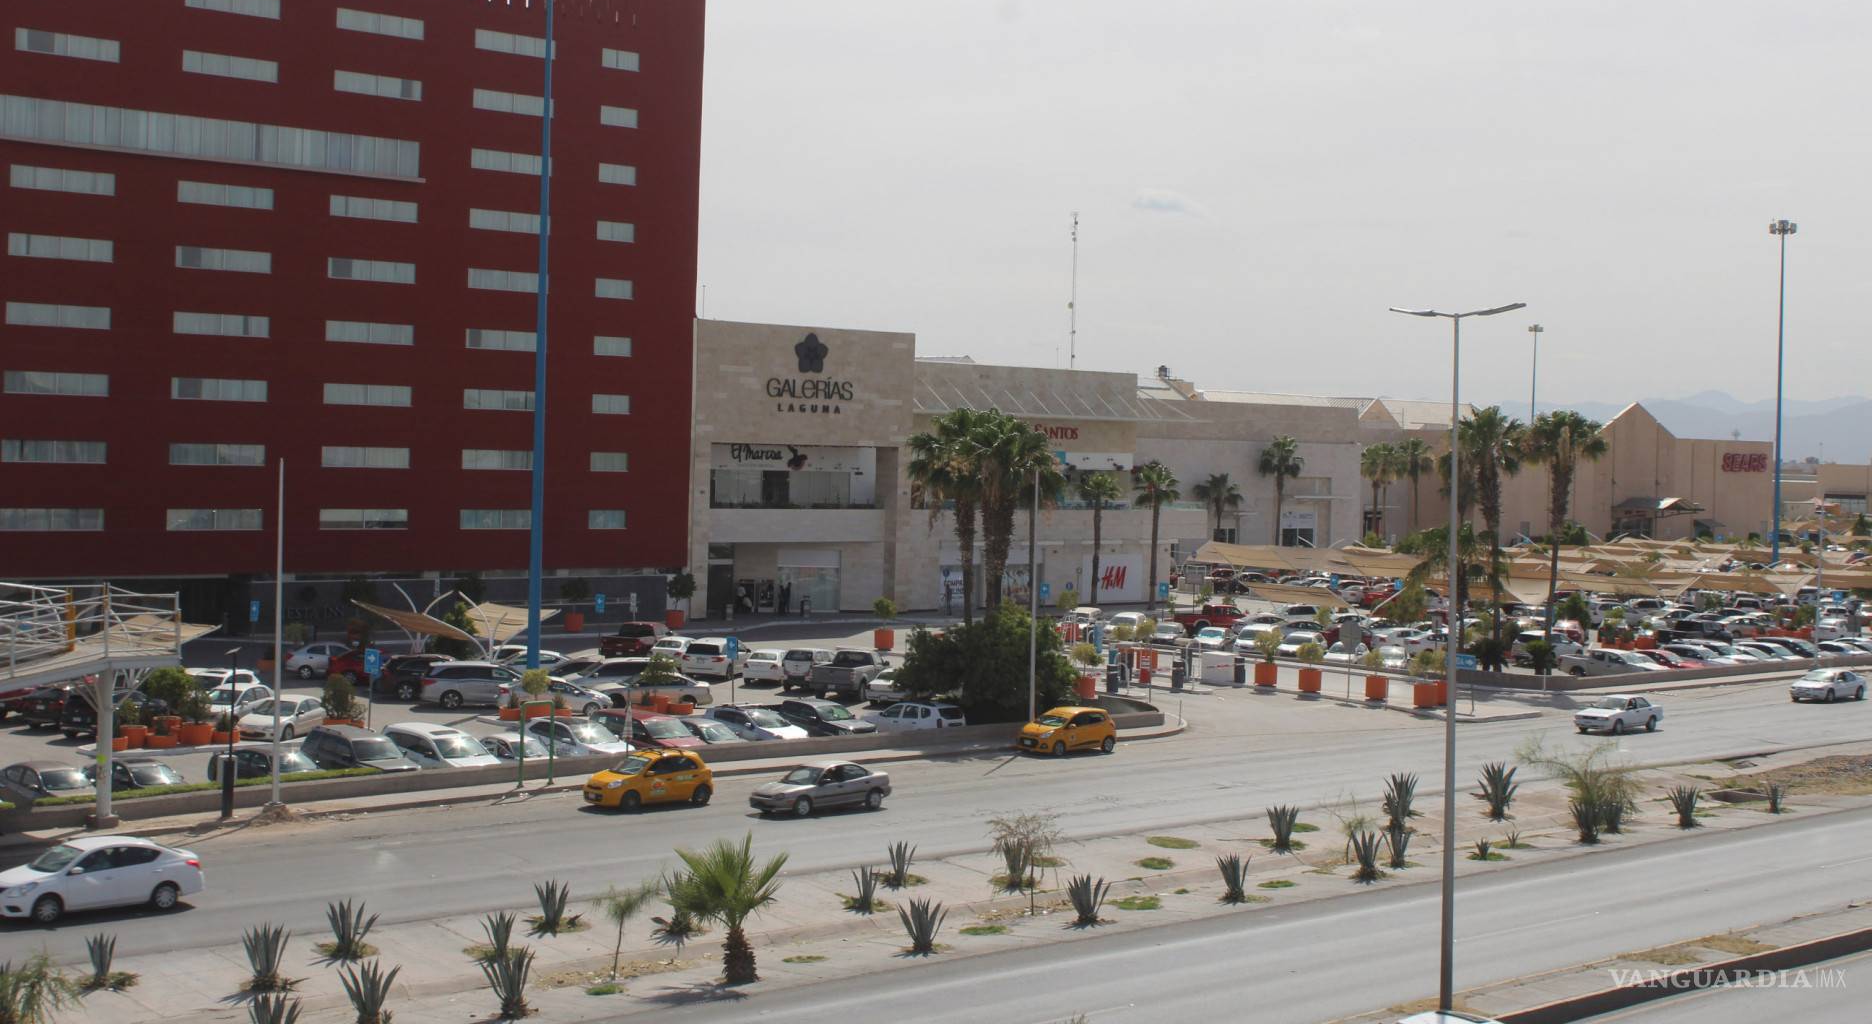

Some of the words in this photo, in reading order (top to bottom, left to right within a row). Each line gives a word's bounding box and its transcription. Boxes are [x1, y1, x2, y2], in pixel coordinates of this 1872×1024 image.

[777, 403, 841, 414] LAGUNA
[1721, 452, 1768, 473] SEARS
[1101, 566, 1127, 590] H&M
